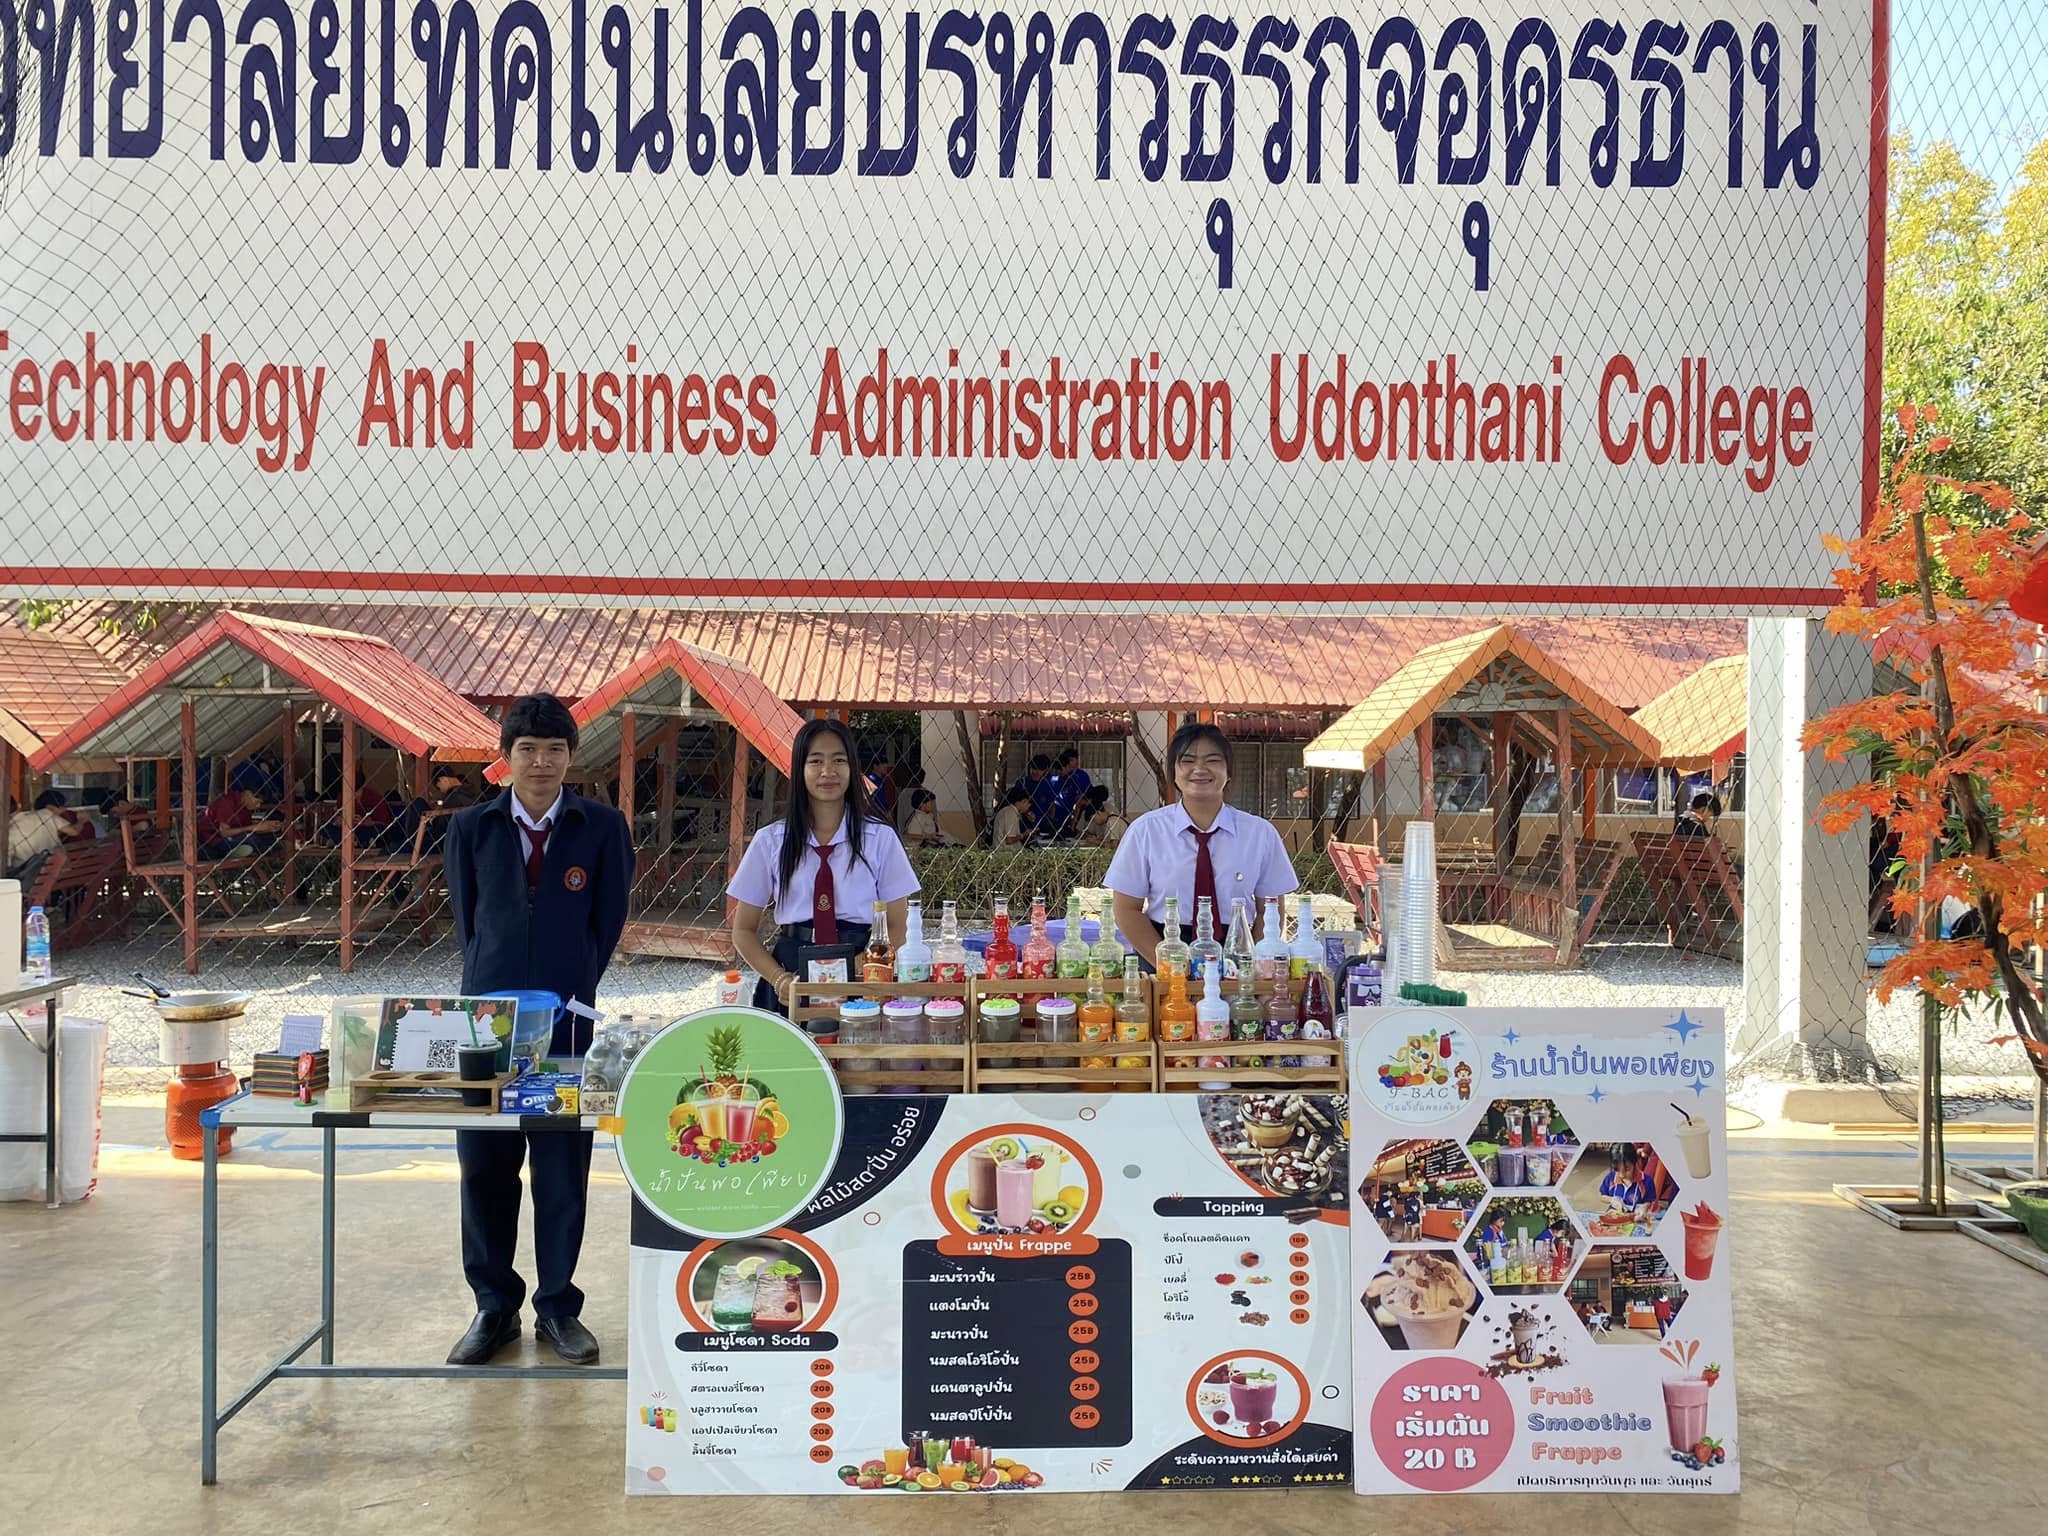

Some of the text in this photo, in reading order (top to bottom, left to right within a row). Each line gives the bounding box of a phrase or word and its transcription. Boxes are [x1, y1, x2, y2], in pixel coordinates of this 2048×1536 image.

[357, 338, 475, 450] And
[511, 341, 777, 458] Business
[810, 346, 1232, 463] Administration
[1269, 351, 1562, 464] Udonthani
[1598, 353, 1814, 493] College
[1490, 1044, 1715, 1079] ร้านน้ำปั่นพอเพียง
[891, 1106, 920, 1147] อร่อย
[1203, 1200, 1265, 1216] Topping
[967, 1235, 1073, 1255] เมนูปั่น Frappe
[929, 1268, 996, 1284] มะพร้าวปั่น
[929, 1295, 990, 1312] แตงโมปั่น
[703, 1332, 811, 1351] เมนูโซดา Soda
[930, 1324, 989, 1341] มะนาวปั่น
[691, 1361, 730, 1374] กีวี่โซดา
[929, 1350, 1020, 1367] นมสดโอริโอ้ปั่น
[930, 1377, 1013, 1397] แคนตาลูปปั่น
[1402, 1384, 1480, 1403] ราคา
[1529, 1386, 1594, 1405] Fruit
[690, 1402, 758, 1417] บลูฮาวายโซดา
[930, 1404, 1013, 1422] นมสดปีโป้ปั่น
[1395, 1411, 1489, 1437] เริ่มต้น
[1527, 1412, 1652, 1432] Smoothie
[691, 1443, 738, 1456] ลิ้นจี่โซดา
[1174, 1447, 1339, 1466] ระดับความหวานสั่งได้เลยค่า
[1403, 1448, 1445, 1470] 20
[1531, 1442, 1623, 1465] Frappe
[1641, 1476, 1662, 1487] และ
[1667, 1475, 1713, 1489] วันศุกร์
